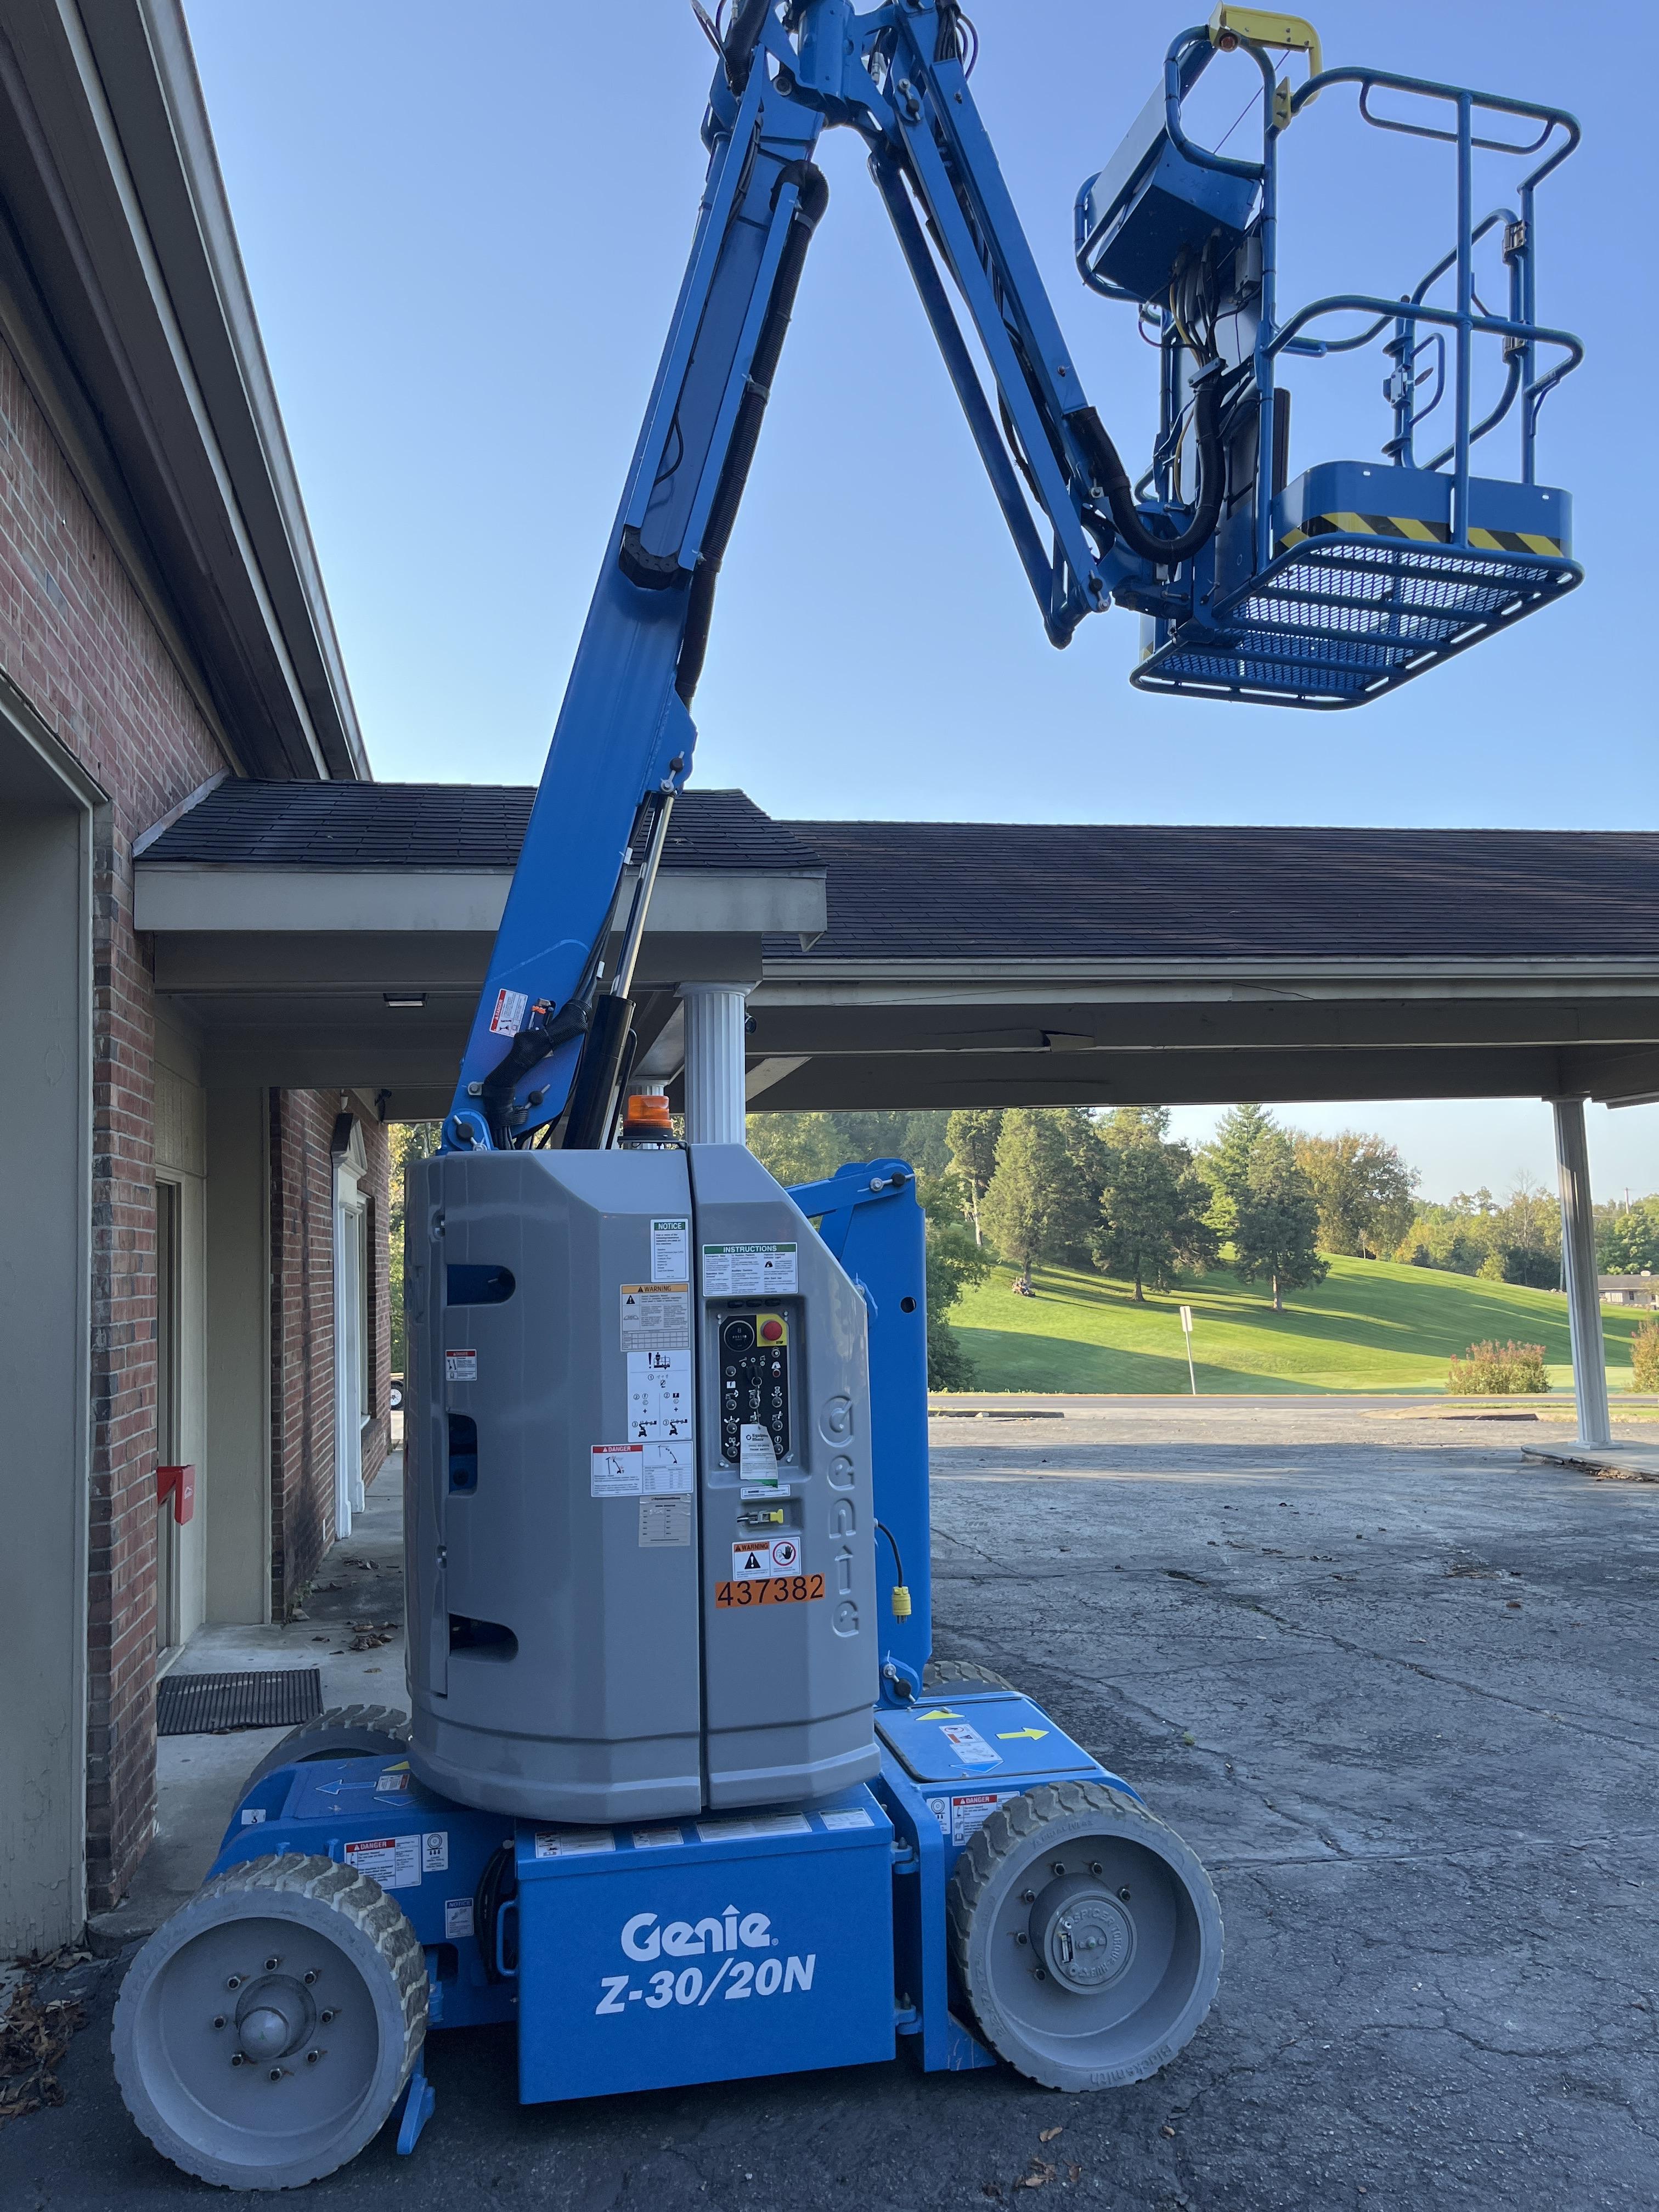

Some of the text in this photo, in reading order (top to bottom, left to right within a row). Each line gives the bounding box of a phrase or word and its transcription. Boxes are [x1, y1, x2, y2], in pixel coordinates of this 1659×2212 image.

[718, 1574, 823, 1606] 437382
[360, 1841, 387, 1850] DANGER
[621, 1904, 771, 1961] Genie
[595, 1953, 816, 2015] Z-30/20N
